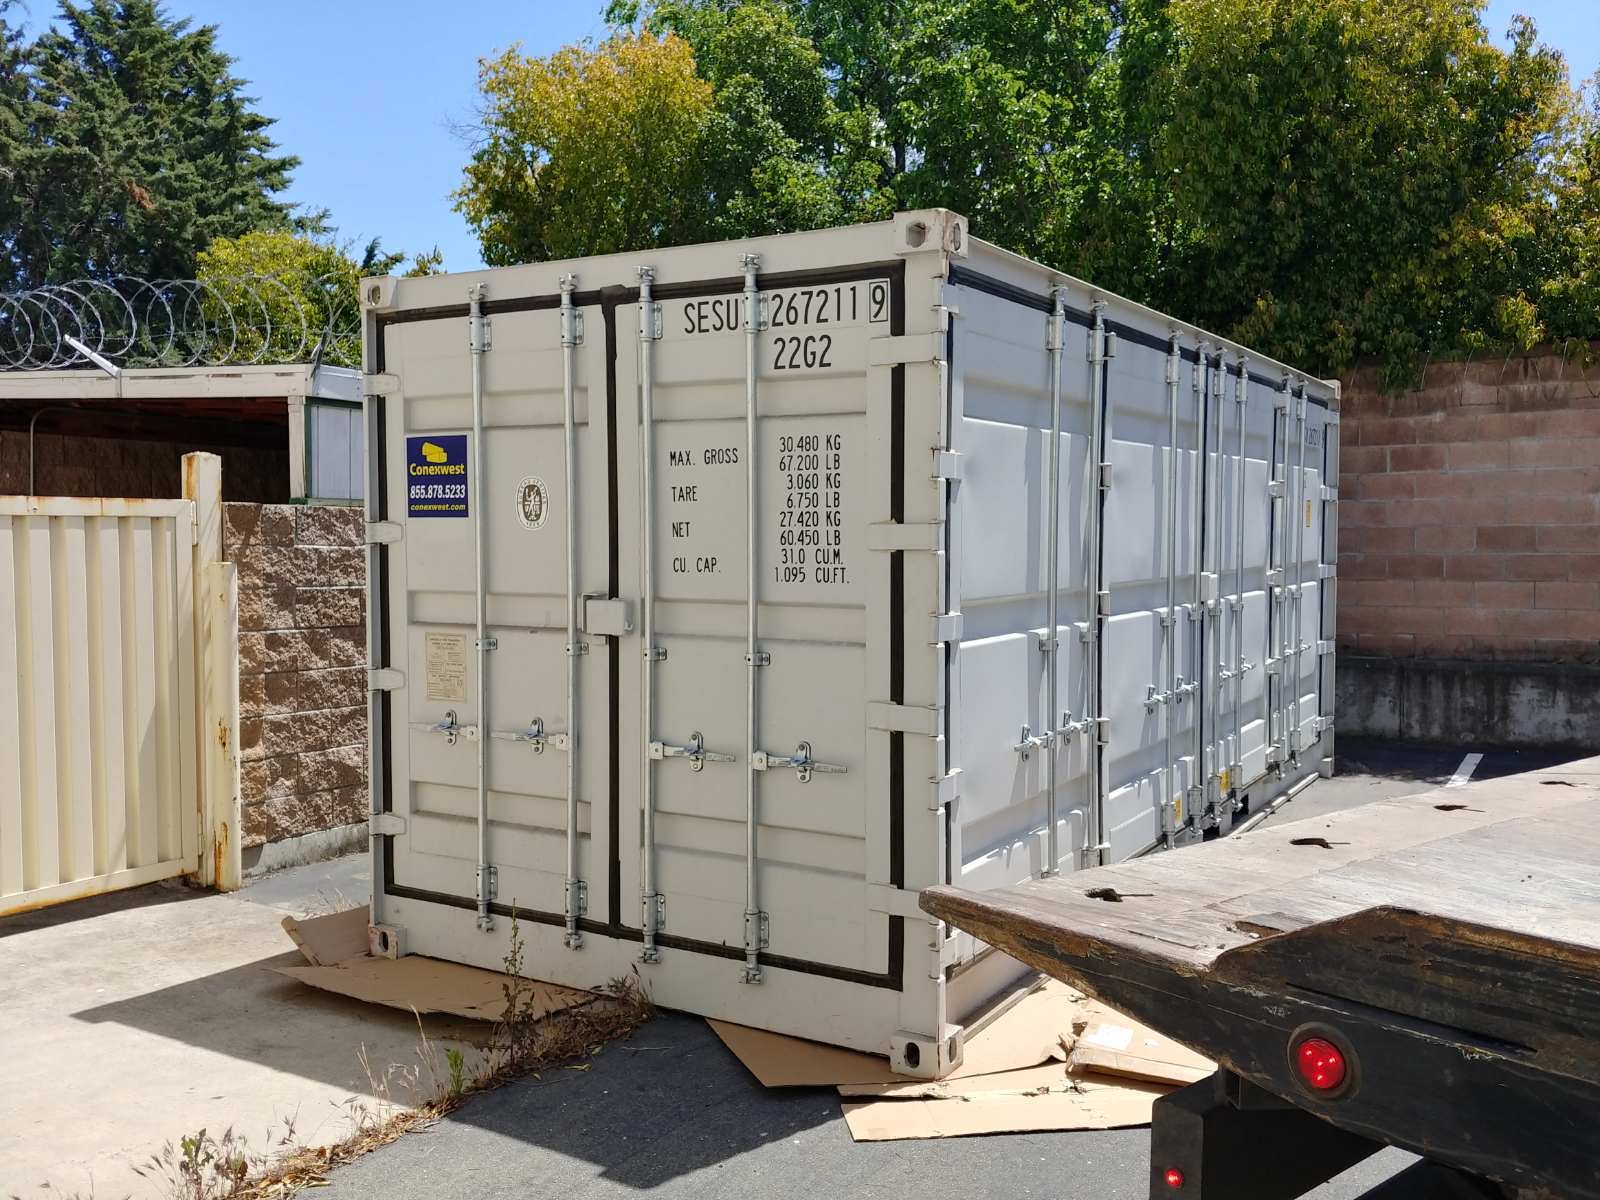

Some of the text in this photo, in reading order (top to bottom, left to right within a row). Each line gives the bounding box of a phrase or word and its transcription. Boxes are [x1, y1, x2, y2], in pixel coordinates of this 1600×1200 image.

[684, 284, 886, 334] SESU 267211 9
[773, 334, 832, 370] 22G2
[779, 434, 841, 453] 30.480 KG
[670, 448, 738, 466] MAX. GROSS
[779, 454, 841, 471] 67.200 LB
[410, 462, 465, 476] Conexwest
[786, 472, 841, 490] 3.060 KG
[410, 484, 466, 500] 855.878.5233
[672, 486, 698, 502] TARE
[786, 492, 841, 508] 6.750 LB
[410, 503, 466, 511] conexwest.com
[779, 510, 841, 528] 27.420 KG
[672, 522, 690, 538] NET
[780, 530, 841, 546] 60.450 LB
[673, 556, 721, 573] CU. CAP.
[781, 548, 843, 565] 31.0 CU.M.
[775, 566, 850, 584] 1.095 CU.FT.
